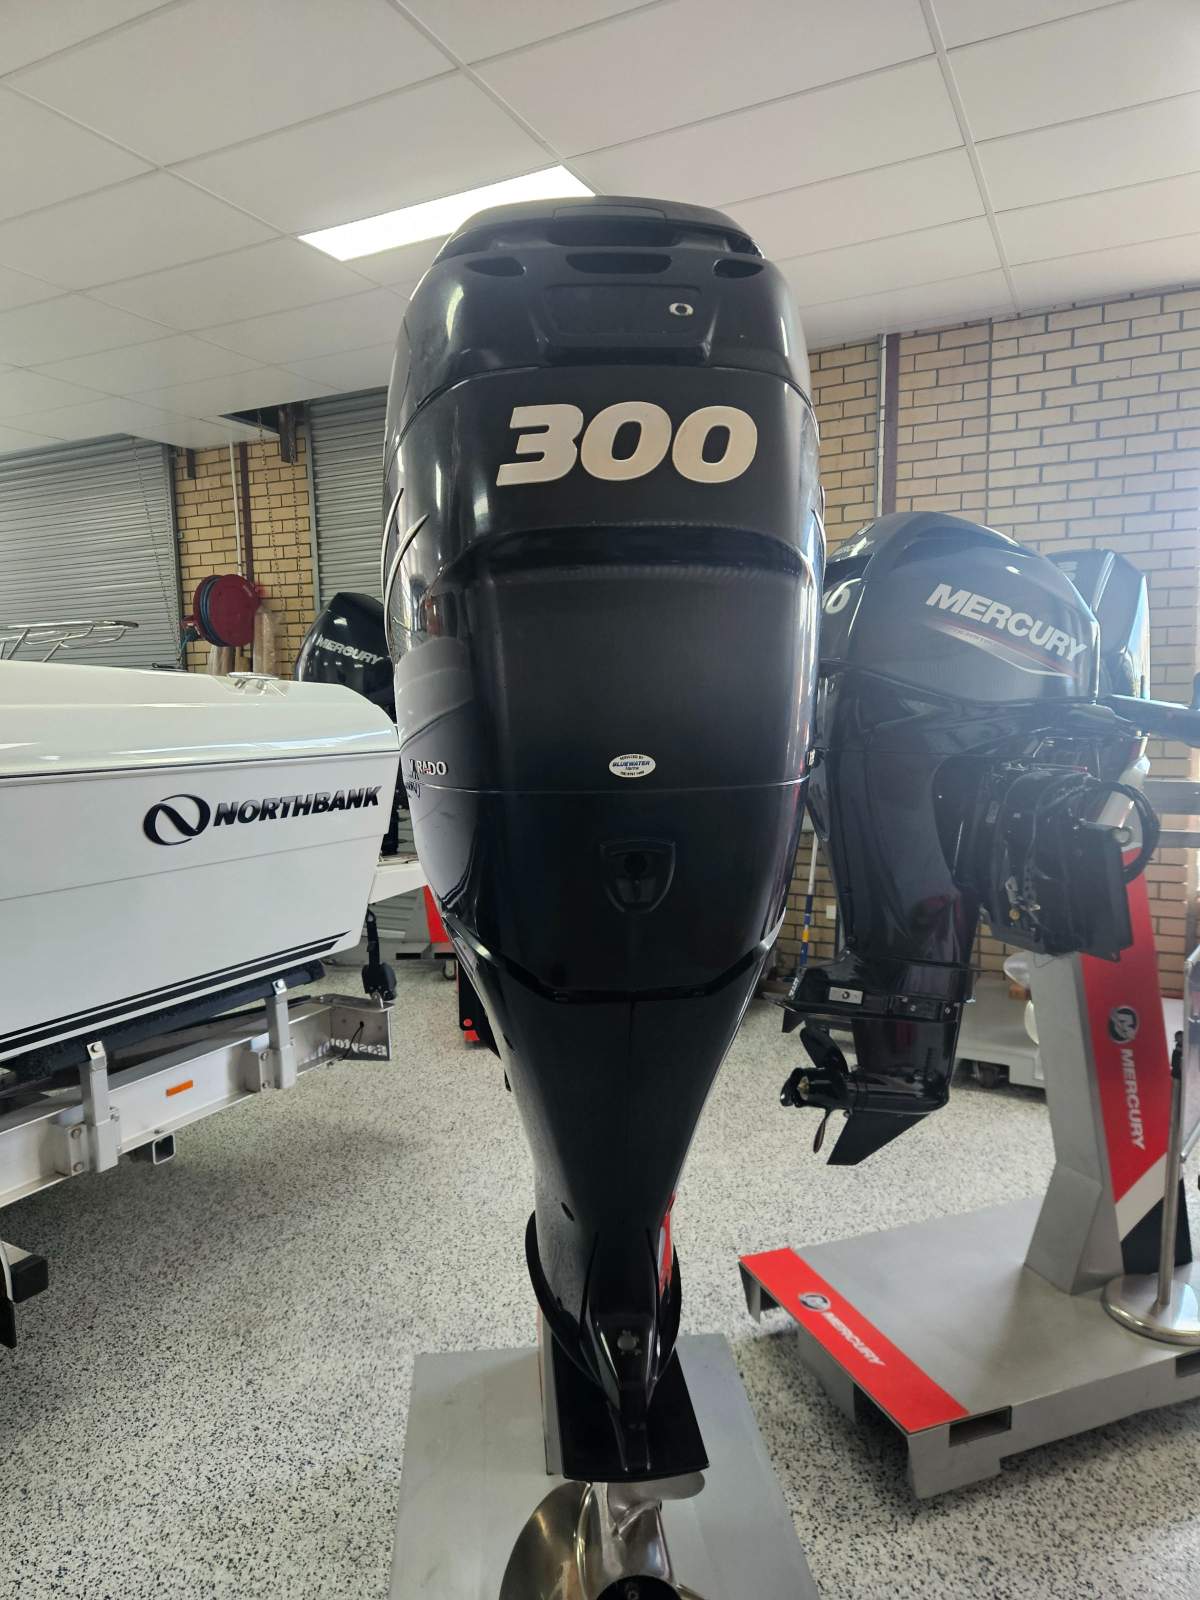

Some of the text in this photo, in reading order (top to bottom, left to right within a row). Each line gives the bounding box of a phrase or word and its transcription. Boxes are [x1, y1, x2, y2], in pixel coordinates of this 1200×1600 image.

[496, 401, 758, 486] 300
[315, 634, 384, 664] MERCURY
[925, 583, 1087, 662] MERCURY
[213, 785, 383, 827] NORTHBANK
[1119, 1048, 1146, 1151] MERCURY
[821, 1312, 887, 1366] MERCURY
